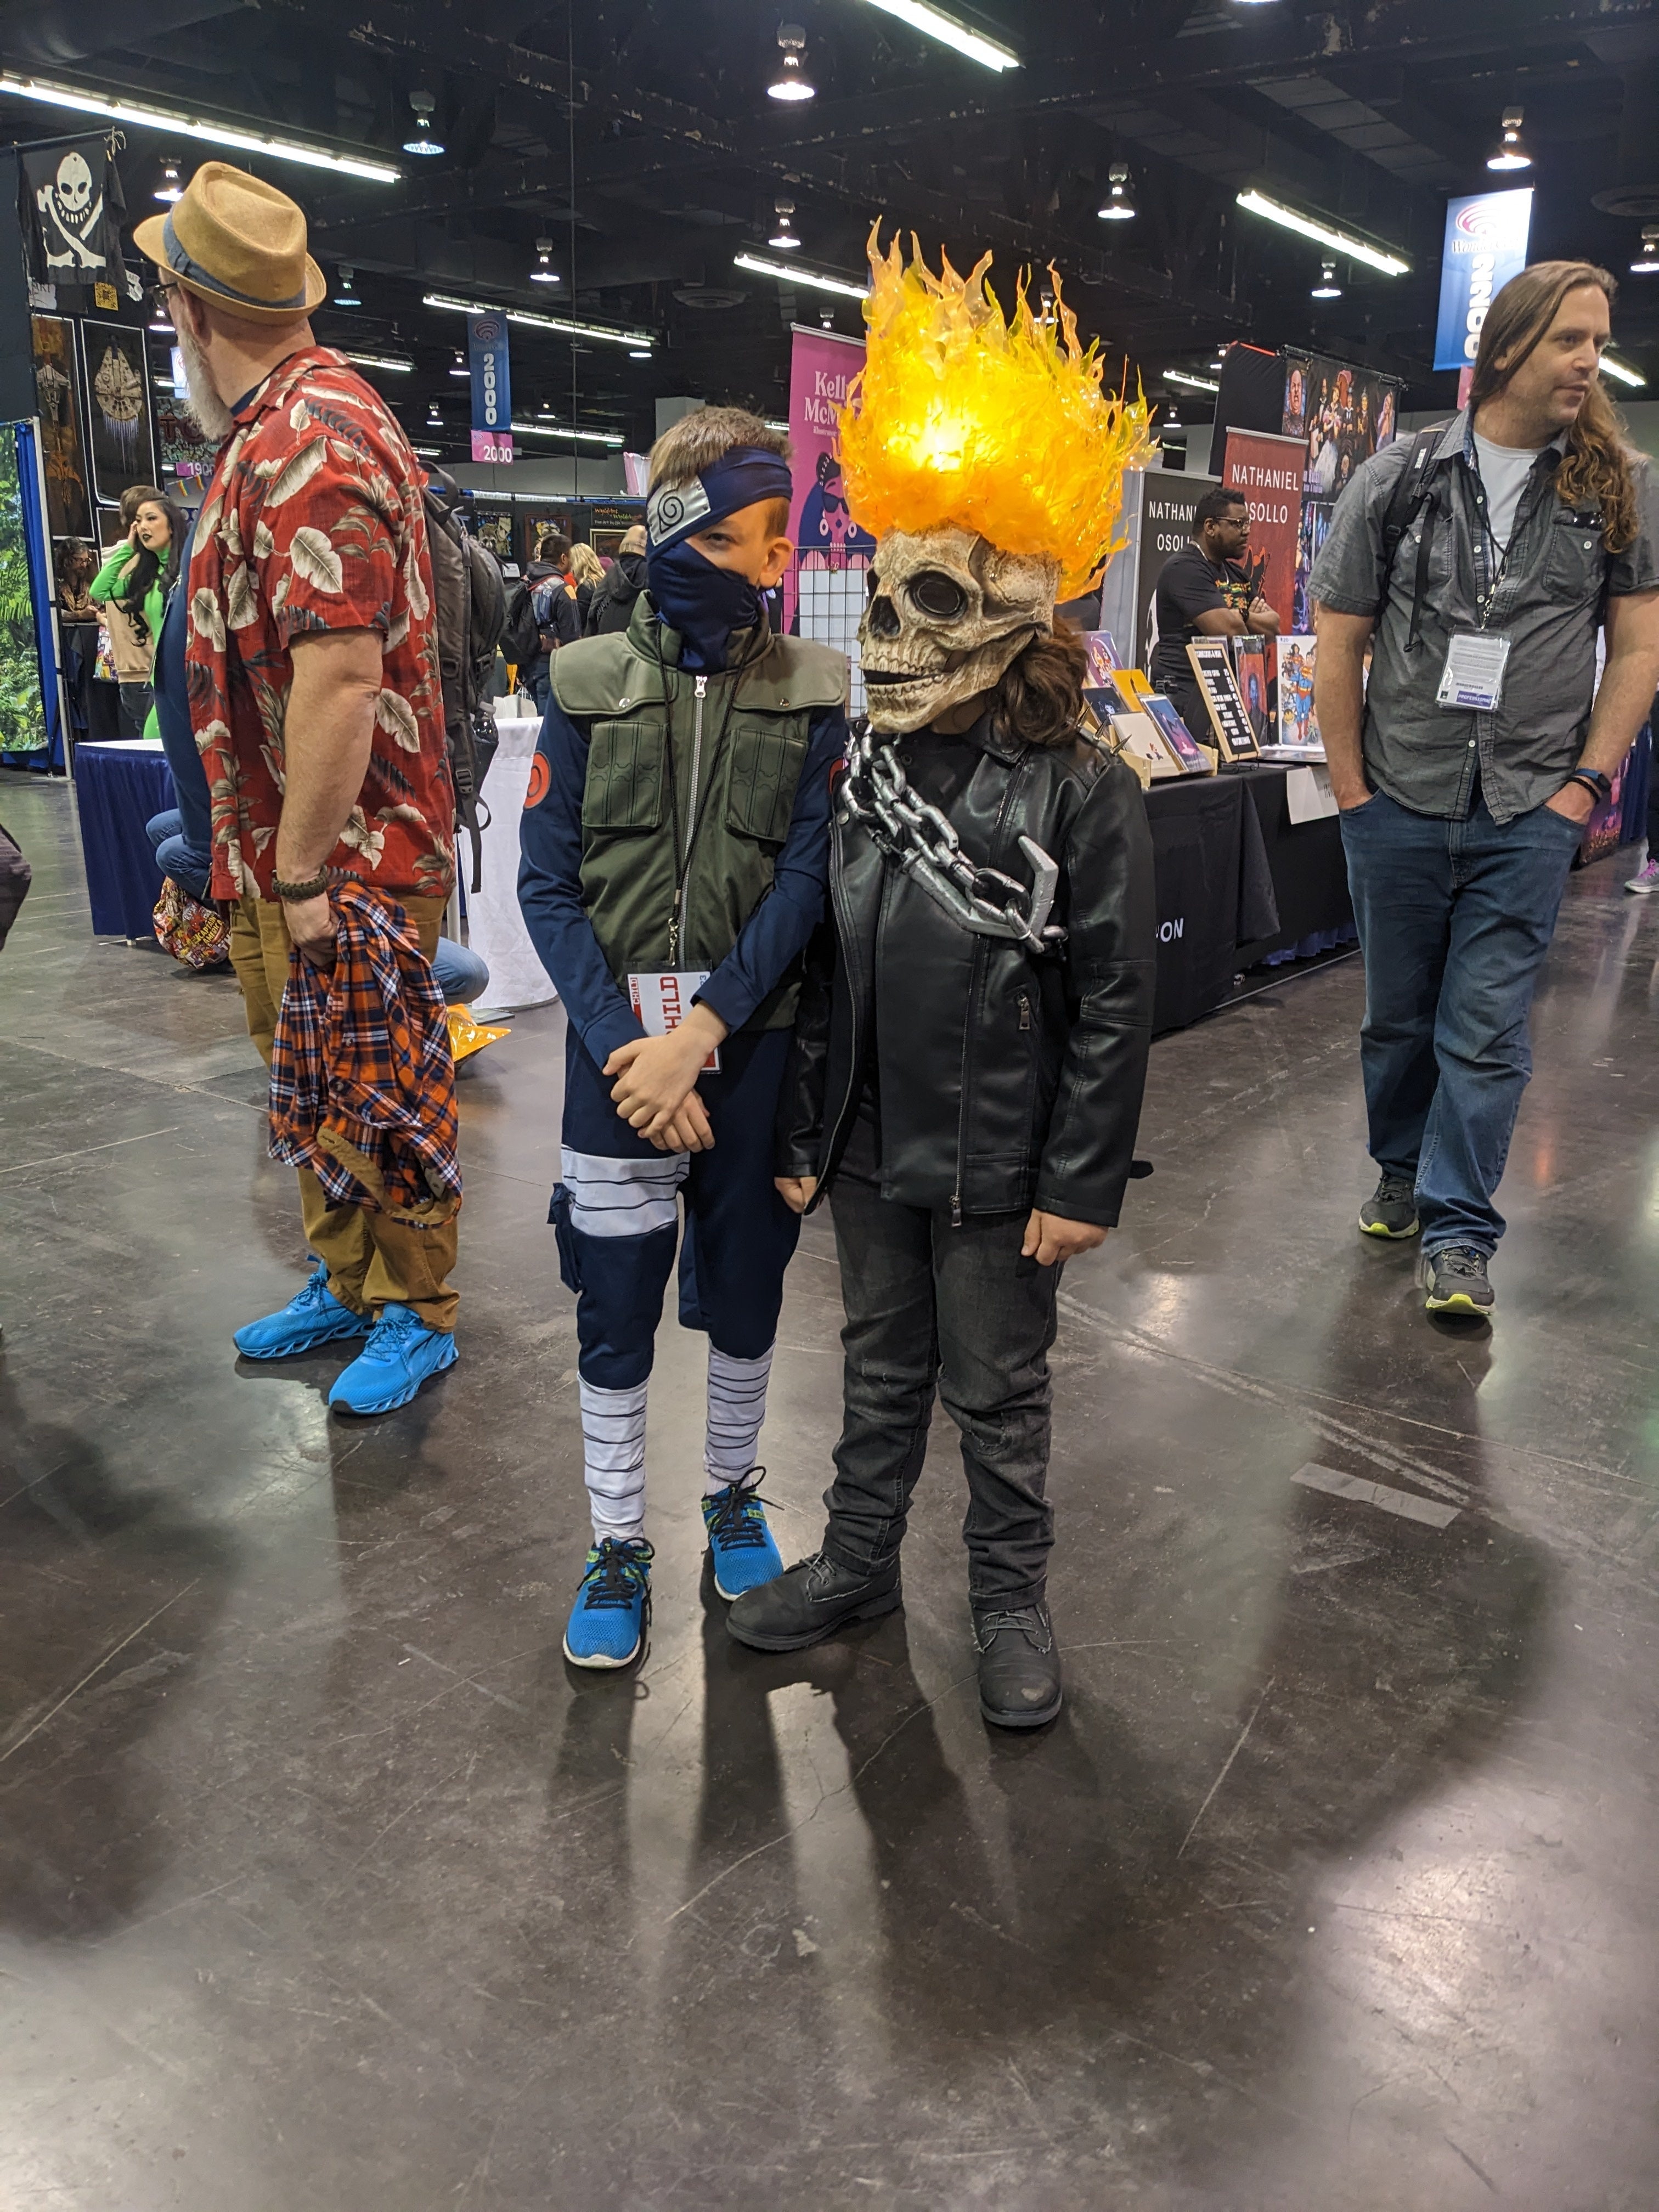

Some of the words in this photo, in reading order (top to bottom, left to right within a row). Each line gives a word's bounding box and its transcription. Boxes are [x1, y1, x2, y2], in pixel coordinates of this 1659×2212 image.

[1464, 253, 1496, 360] 2200
[483, 353, 497, 425] 2000
[815, 370, 847, 408] Kell
[483, 445, 512, 464] 2000
[1232, 464, 1299, 491] NATHANIEL
[1149, 500, 1197, 522] NATHAN
[1244, 501, 1288, 524] SOLLO
[198, 916, 217, 940] CAPTAIN
[203, 919, 222, 945] AMERICA
[1156, 917, 1184, 943] ON
[630, 977, 640, 1005] CHILD
[659, 977, 682, 1034] HILD
